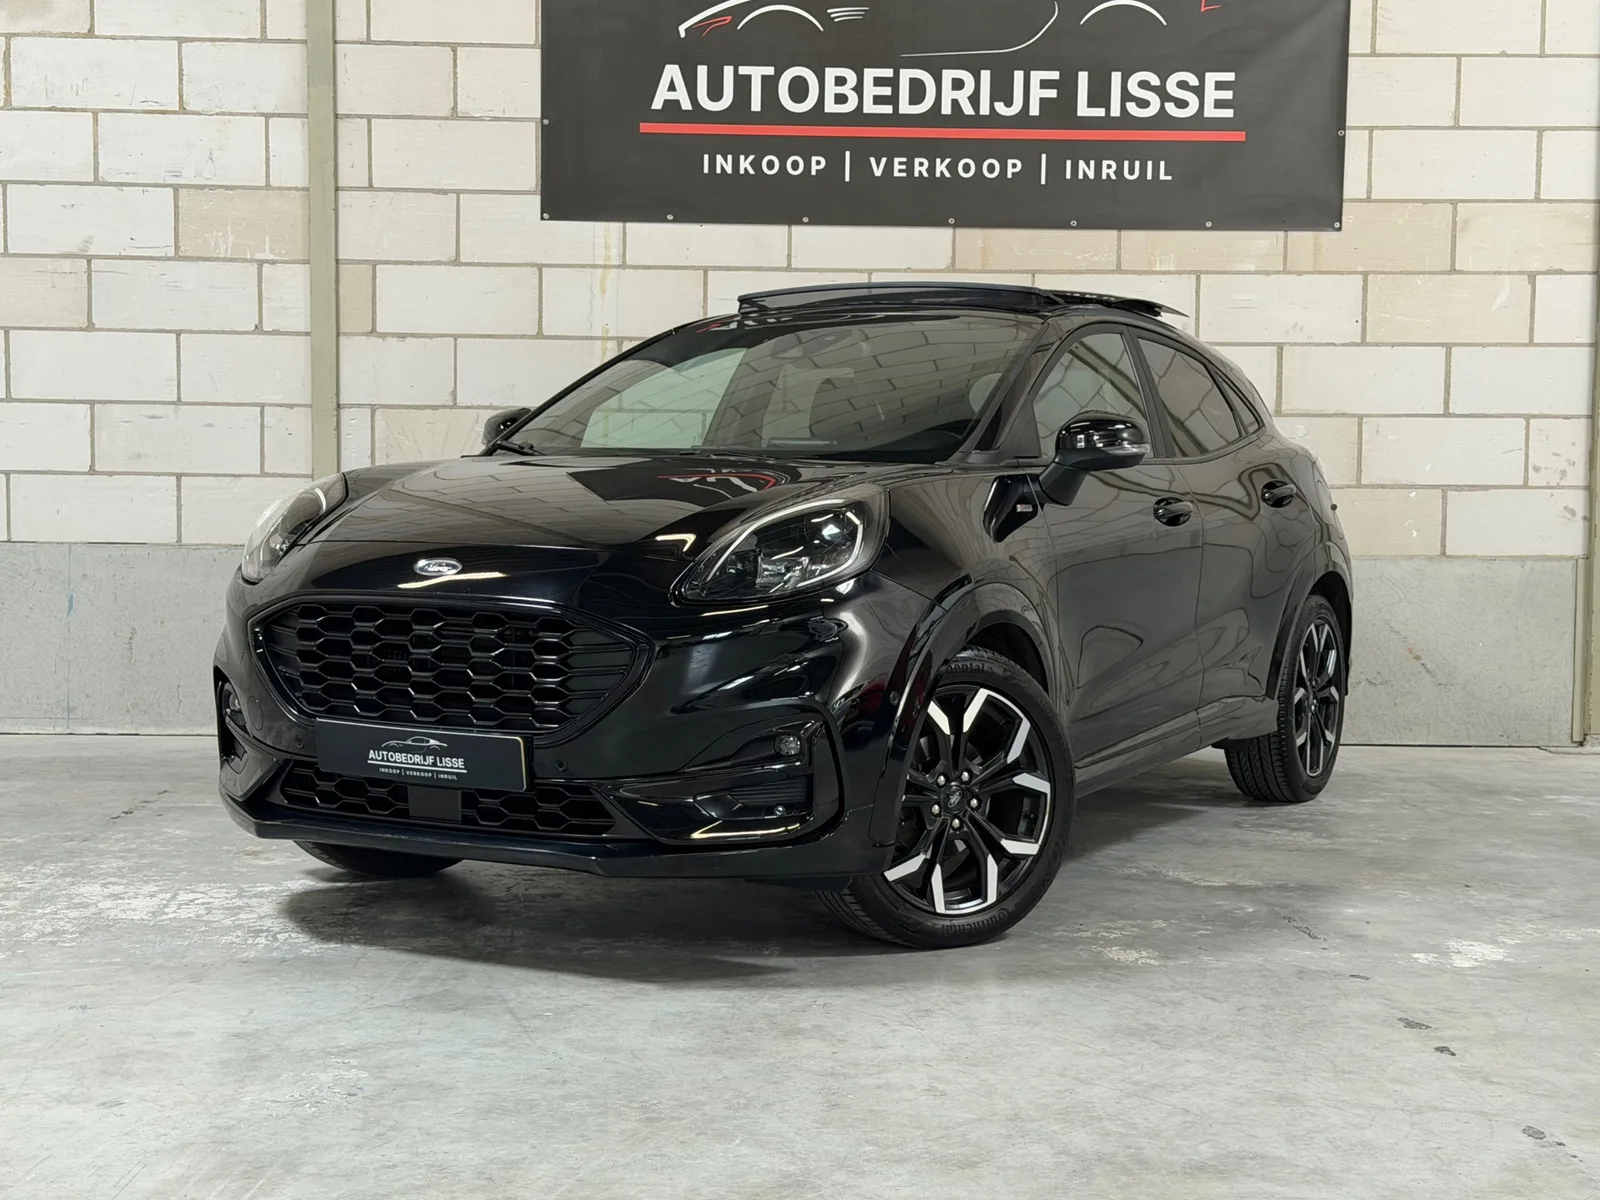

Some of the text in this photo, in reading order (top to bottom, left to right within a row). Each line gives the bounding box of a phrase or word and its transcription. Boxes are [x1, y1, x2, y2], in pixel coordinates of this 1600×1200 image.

[650, 64, 1236, 119] AUTOBEDRIJF LISSE
[703, 153, 827, 176] INKOOP
[869, 156, 1023, 179] VERKOOP
[1065, 159, 1173, 182] INRUIL
[368, 749, 465, 768] AUTOBEDRIJF LISSE
